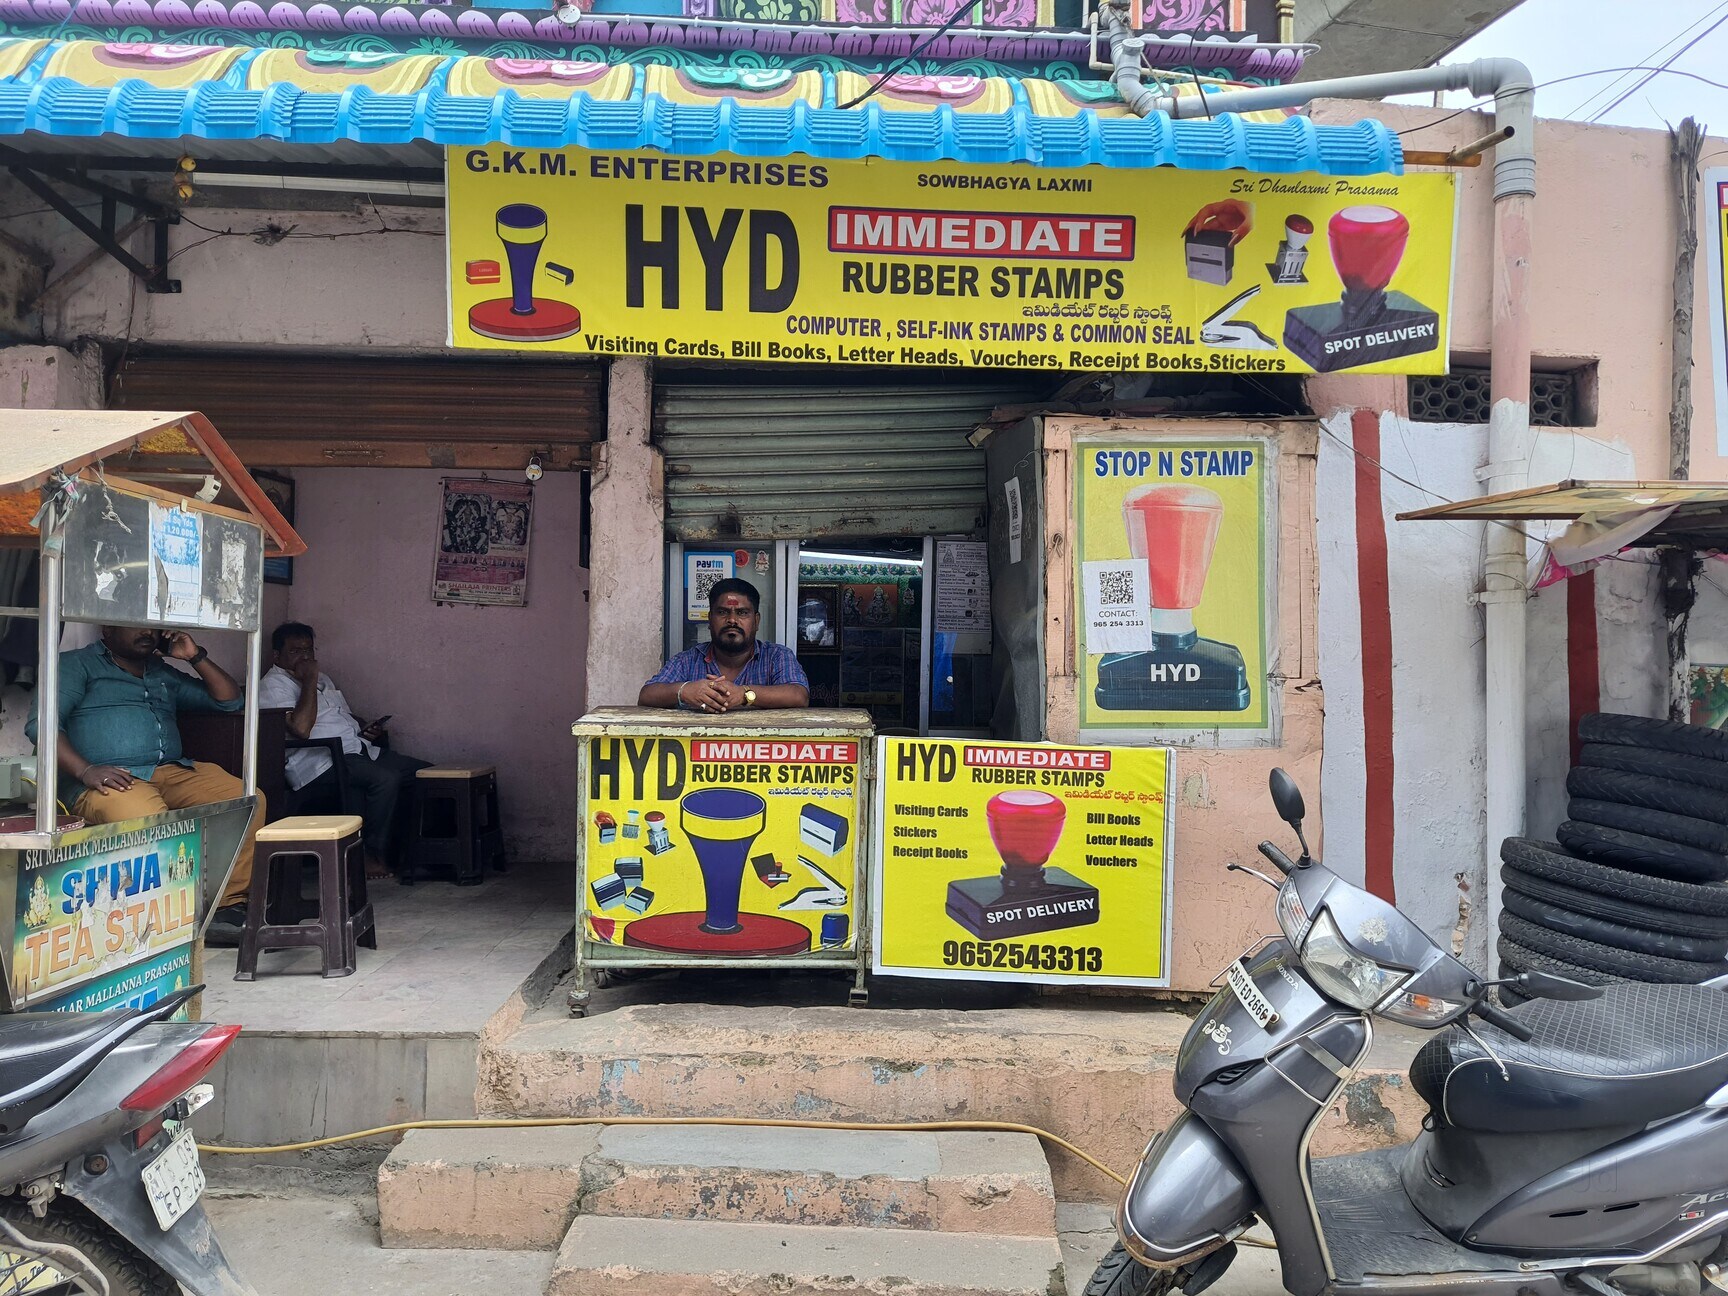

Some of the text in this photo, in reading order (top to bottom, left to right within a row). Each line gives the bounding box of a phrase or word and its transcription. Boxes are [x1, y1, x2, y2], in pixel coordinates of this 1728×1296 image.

[465, 150, 829, 188] G.K.M. ENTERPRISES
[917, 173, 1092, 193] SOWBHAGYA LAXMI
[1230, 178, 1400, 197] Sri Dhanlaxmi Prasanna
[836, 213, 1124, 254] IMMEDIATE
[625, 203, 801, 313] HYD
[842, 261, 1124, 301] RUBBER STAMPS
[786, 315, 881, 338] COMPUTER
[896, 319, 973, 341] SELF-INK
[979, 322, 1047, 342] STAMPS
[1052, 323, 1065, 342] &
[1070, 324, 1147, 344] COMMON
[1152, 325, 1195, 345] SEAL
[1324, 323, 1435, 355] SPOT DELIVERY
[584, 334, 658, 356] Visiting
[664, 338, 725, 359] Cards,
[731, 341, 762, 359] Bill
[767, 342, 831, 362] Books,
[838, 344, 895, 364] Letter
[900, 347, 964, 368] Heads,
[970, 349, 1062, 370] Vouchers,
[1069, 351, 1140, 371] Receipt
[1095, 450, 1255, 477] STOP N STAMP
[1098, 609, 1138, 618] CONTACT:
[1125, 619, 1144, 627] 3313
[1150, 663, 1201, 682] HYD
[699, 742, 849, 761] IMMEDIATE
[897, 742, 956, 783] HYD
[967, 748, 1105, 768] IMMEDIATE
[590, 738, 687, 801] HYD
[692, 764, 854, 784] RUBBER STAMPS
[971, 769, 1105, 787] RUBBER STAMPS
[894, 804, 968, 818] Visiting Cards
[1086, 812, 1141, 826] Bill Books
[25, 819, 196, 871] SRI MAILAR MALLANNA PRASANNA
[893, 826, 937, 838] Stickers
[1086, 833, 1154, 847] Letter Heads
[893, 845, 968, 859] Receipt Books
[1085, 855, 1137, 868] Vouchers
[986, 897, 1095, 924] SPOT DELIVERY
[25, 889, 194, 981] TEA STALL
[943, 940, 1102, 972] 9652543313
[85, 974, 142, 1008] MALLANNA
[144, 954, 190, 985] PRASANNA
[1276, 963, 1299, 990] HONDA
